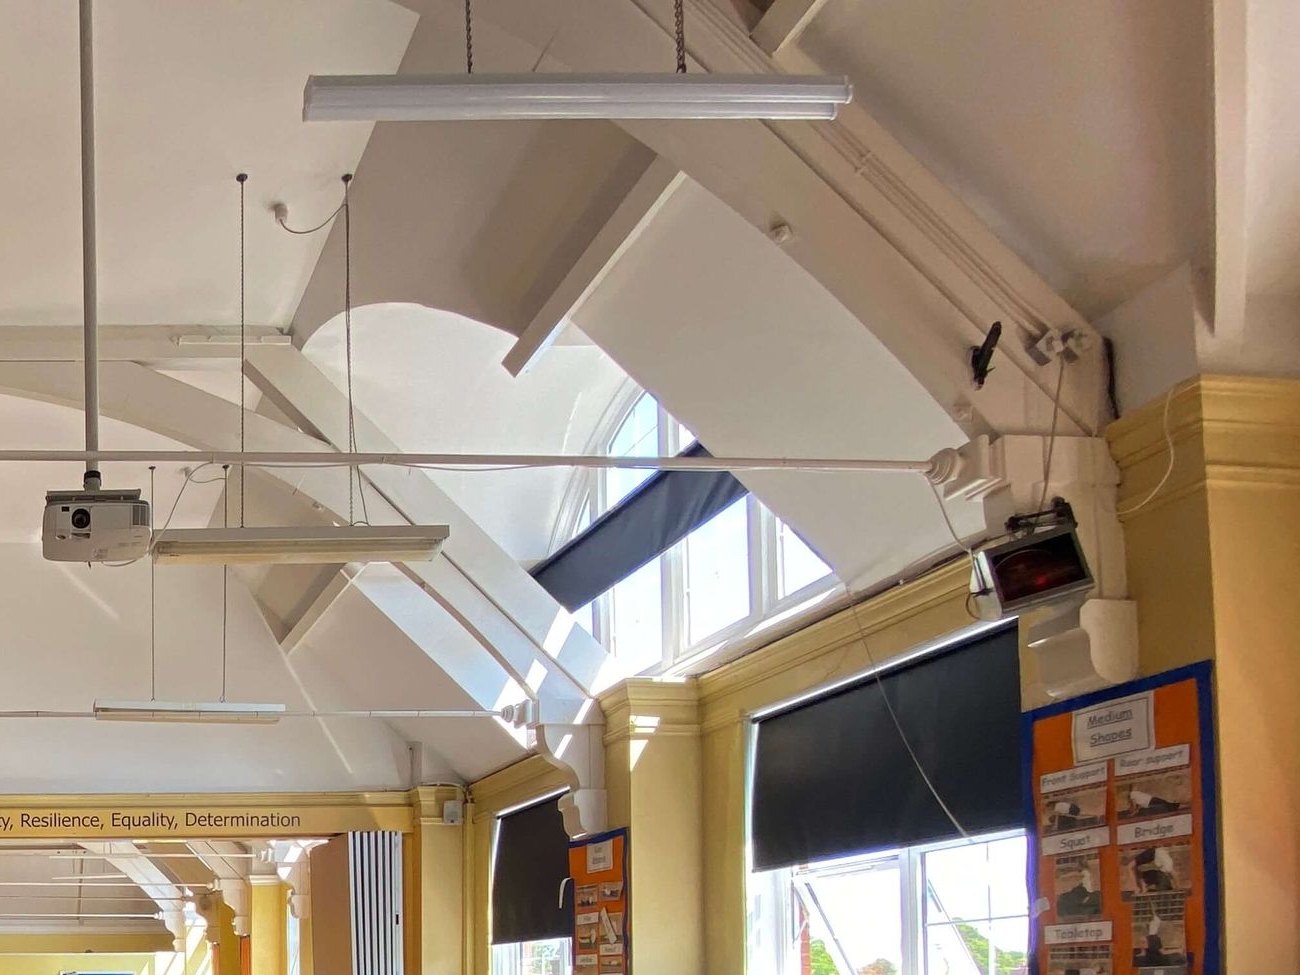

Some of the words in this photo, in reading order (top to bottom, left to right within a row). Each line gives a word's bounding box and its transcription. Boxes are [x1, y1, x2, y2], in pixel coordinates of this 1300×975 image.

[1087, 708, 1133, 728] Medium
[1090, 728, 1133, 747] Shapes
[20, 812, 104, 831] Resilience,
[111, 812, 178, 831] Equality,
[185, 811, 302, 828] Determination
[1134, 823, 1174, 839] Bridge
[1059, 835, 1091, 849] Squat
